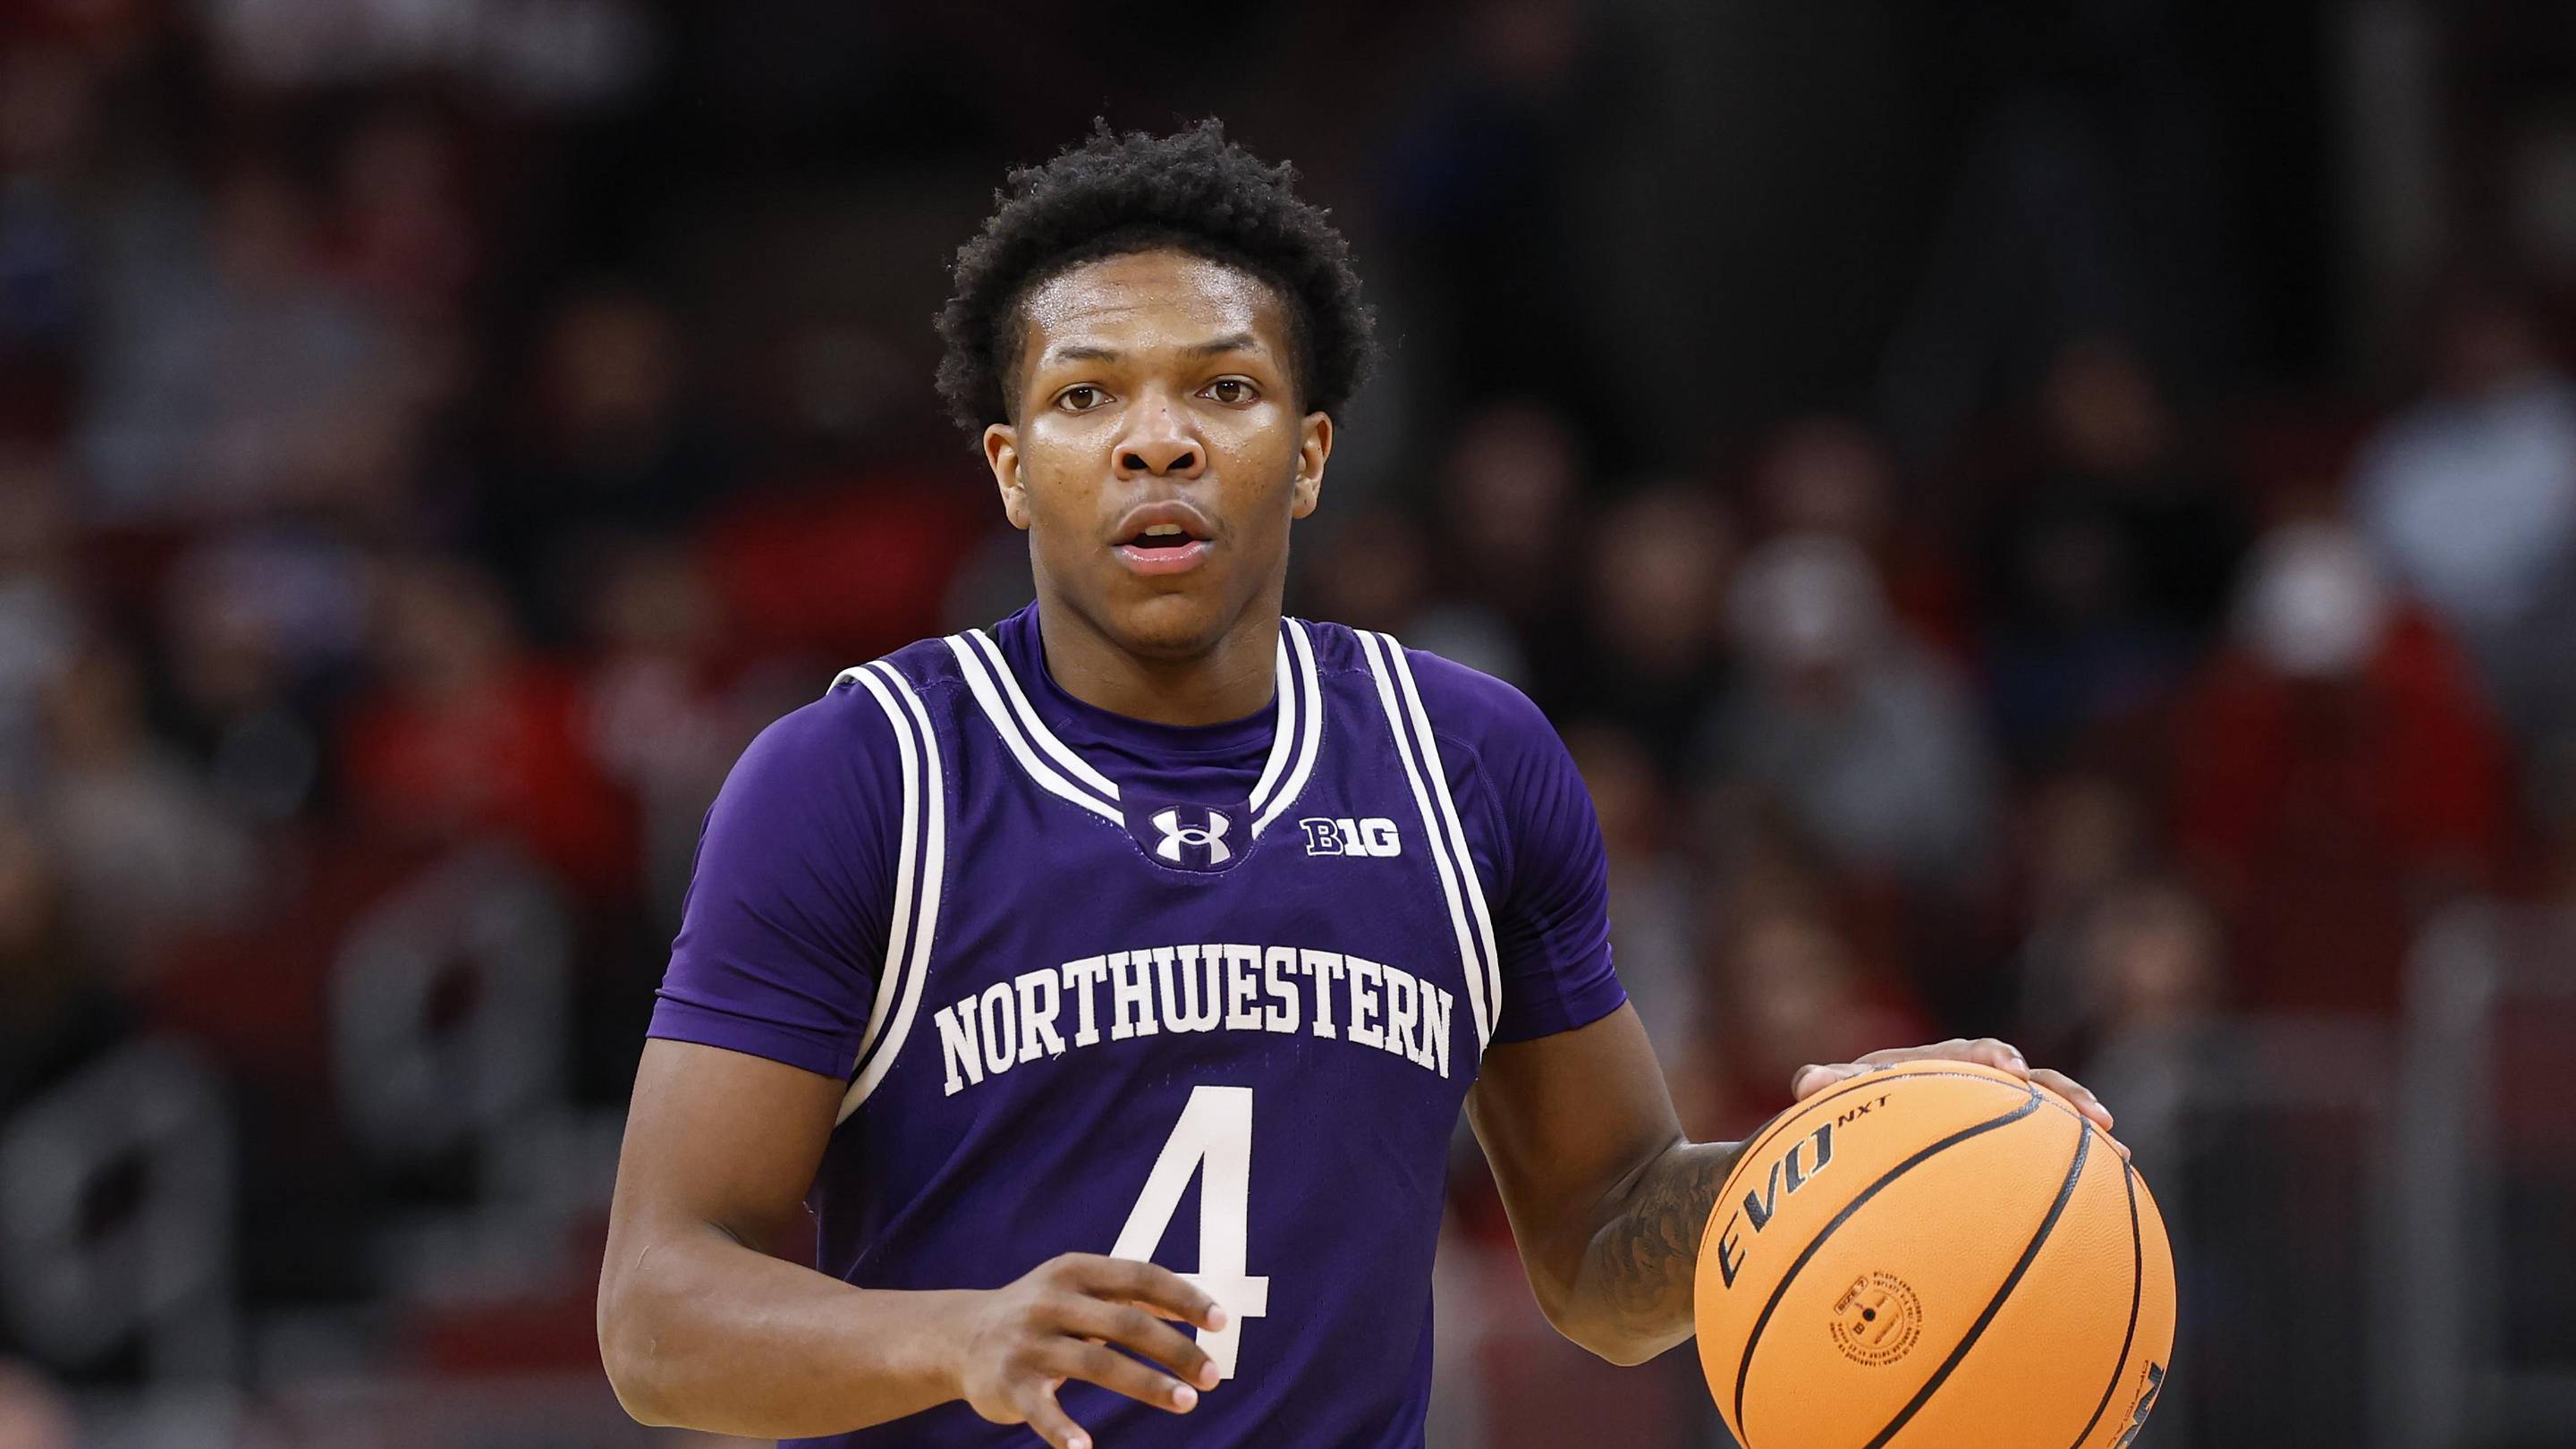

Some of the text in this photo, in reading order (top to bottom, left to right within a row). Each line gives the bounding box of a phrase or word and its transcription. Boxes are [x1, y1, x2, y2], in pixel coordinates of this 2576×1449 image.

[934, 943, 1453, 1097] NORTHWESTERN
[1109, 1085, 1269, 1380] 4
[1717, 1093, 1892, 1291] EVO NXT
